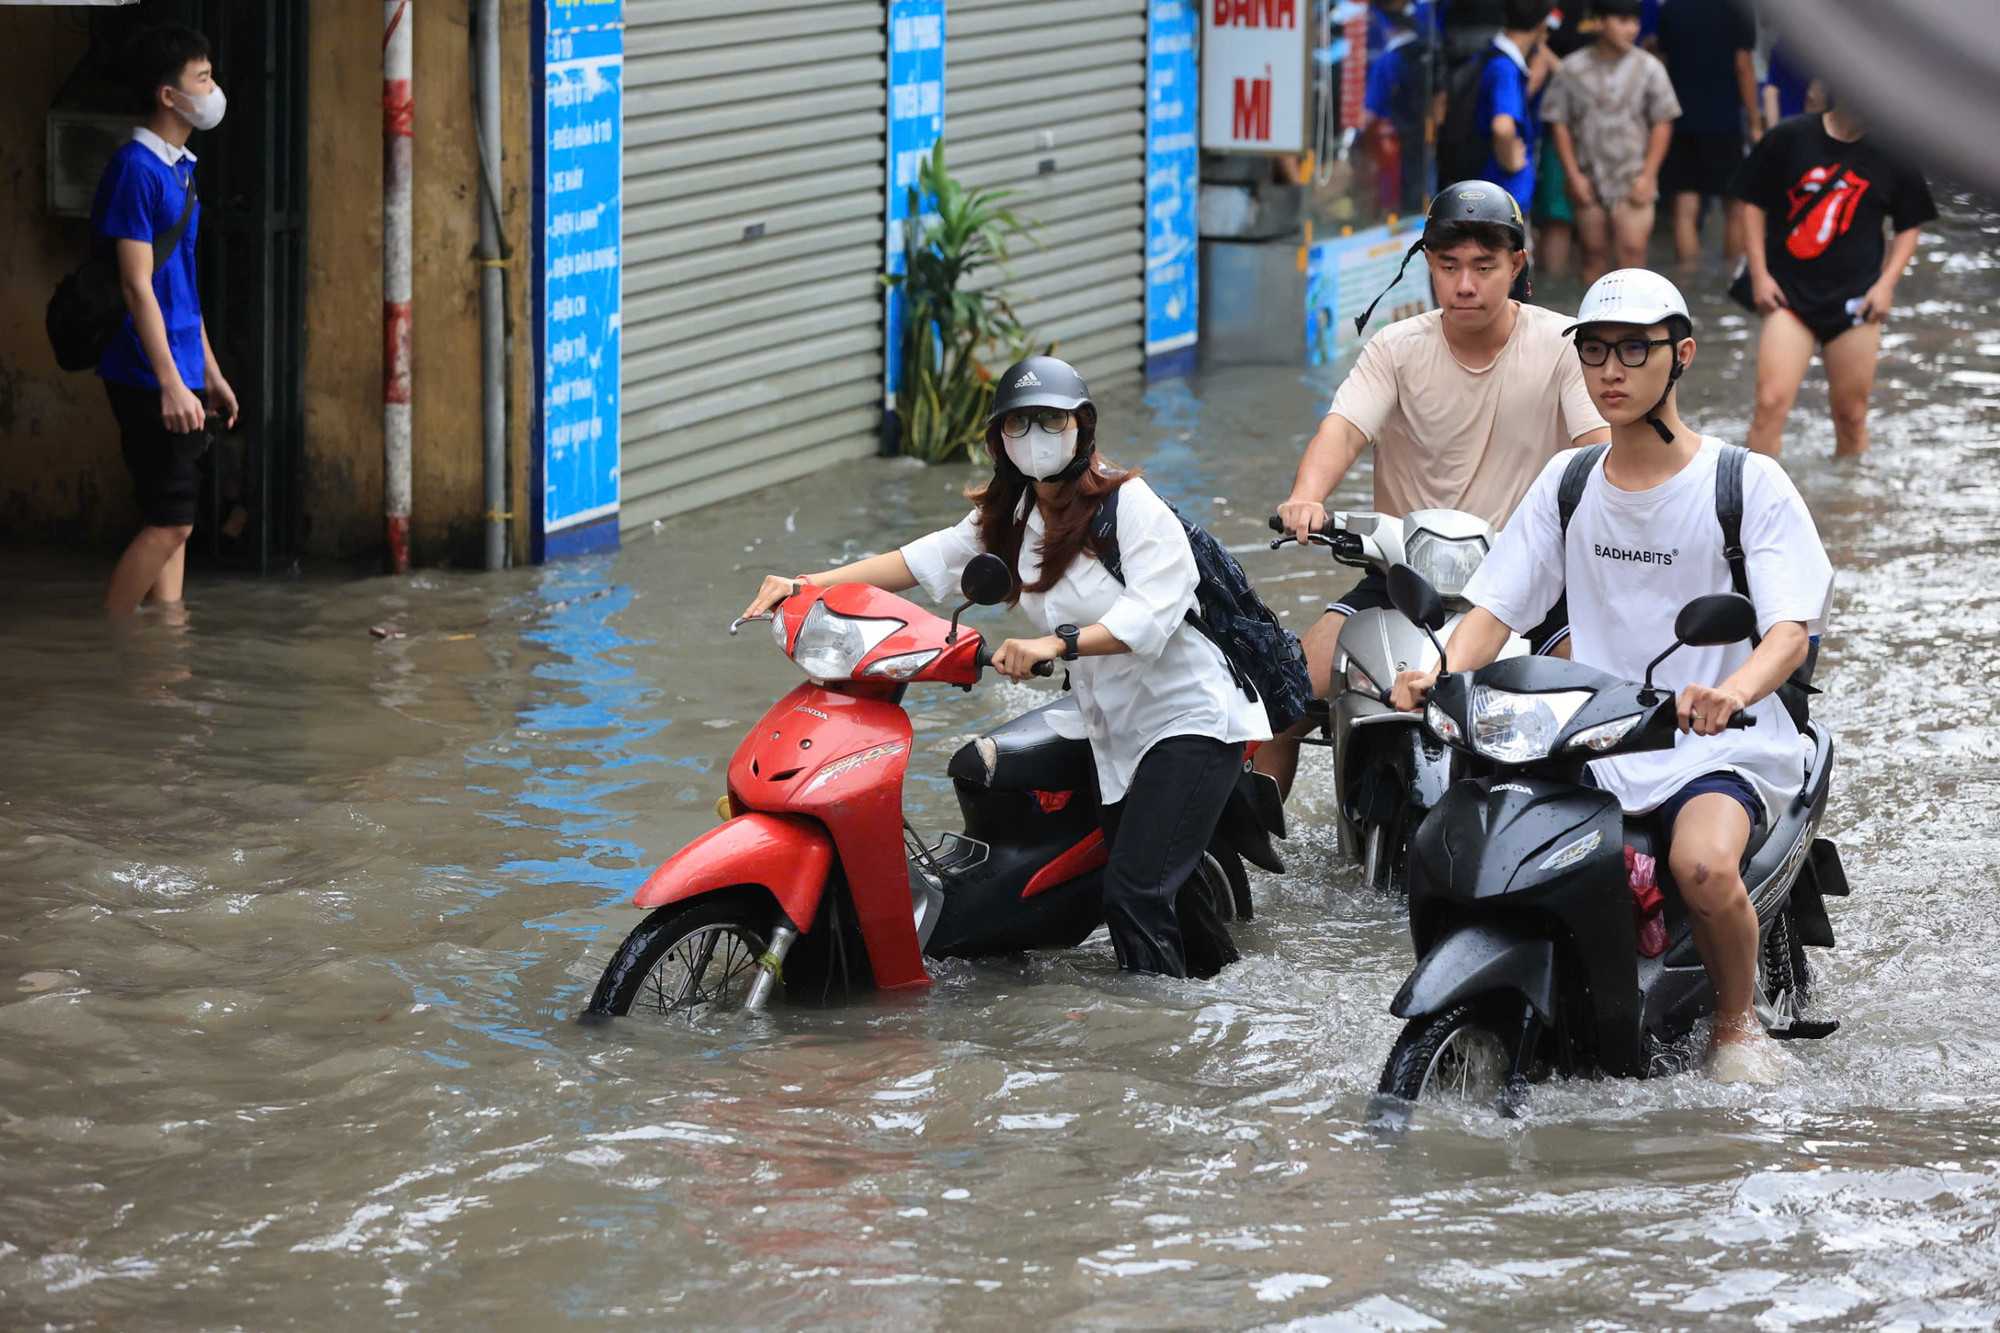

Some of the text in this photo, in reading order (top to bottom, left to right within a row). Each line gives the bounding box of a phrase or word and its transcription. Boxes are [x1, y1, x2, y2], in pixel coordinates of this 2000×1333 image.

[1014, 380, 1042, 389] adidas
[794, 705, 829, 720] HONDA
[1490, 783, 1534, 795] HONDA
